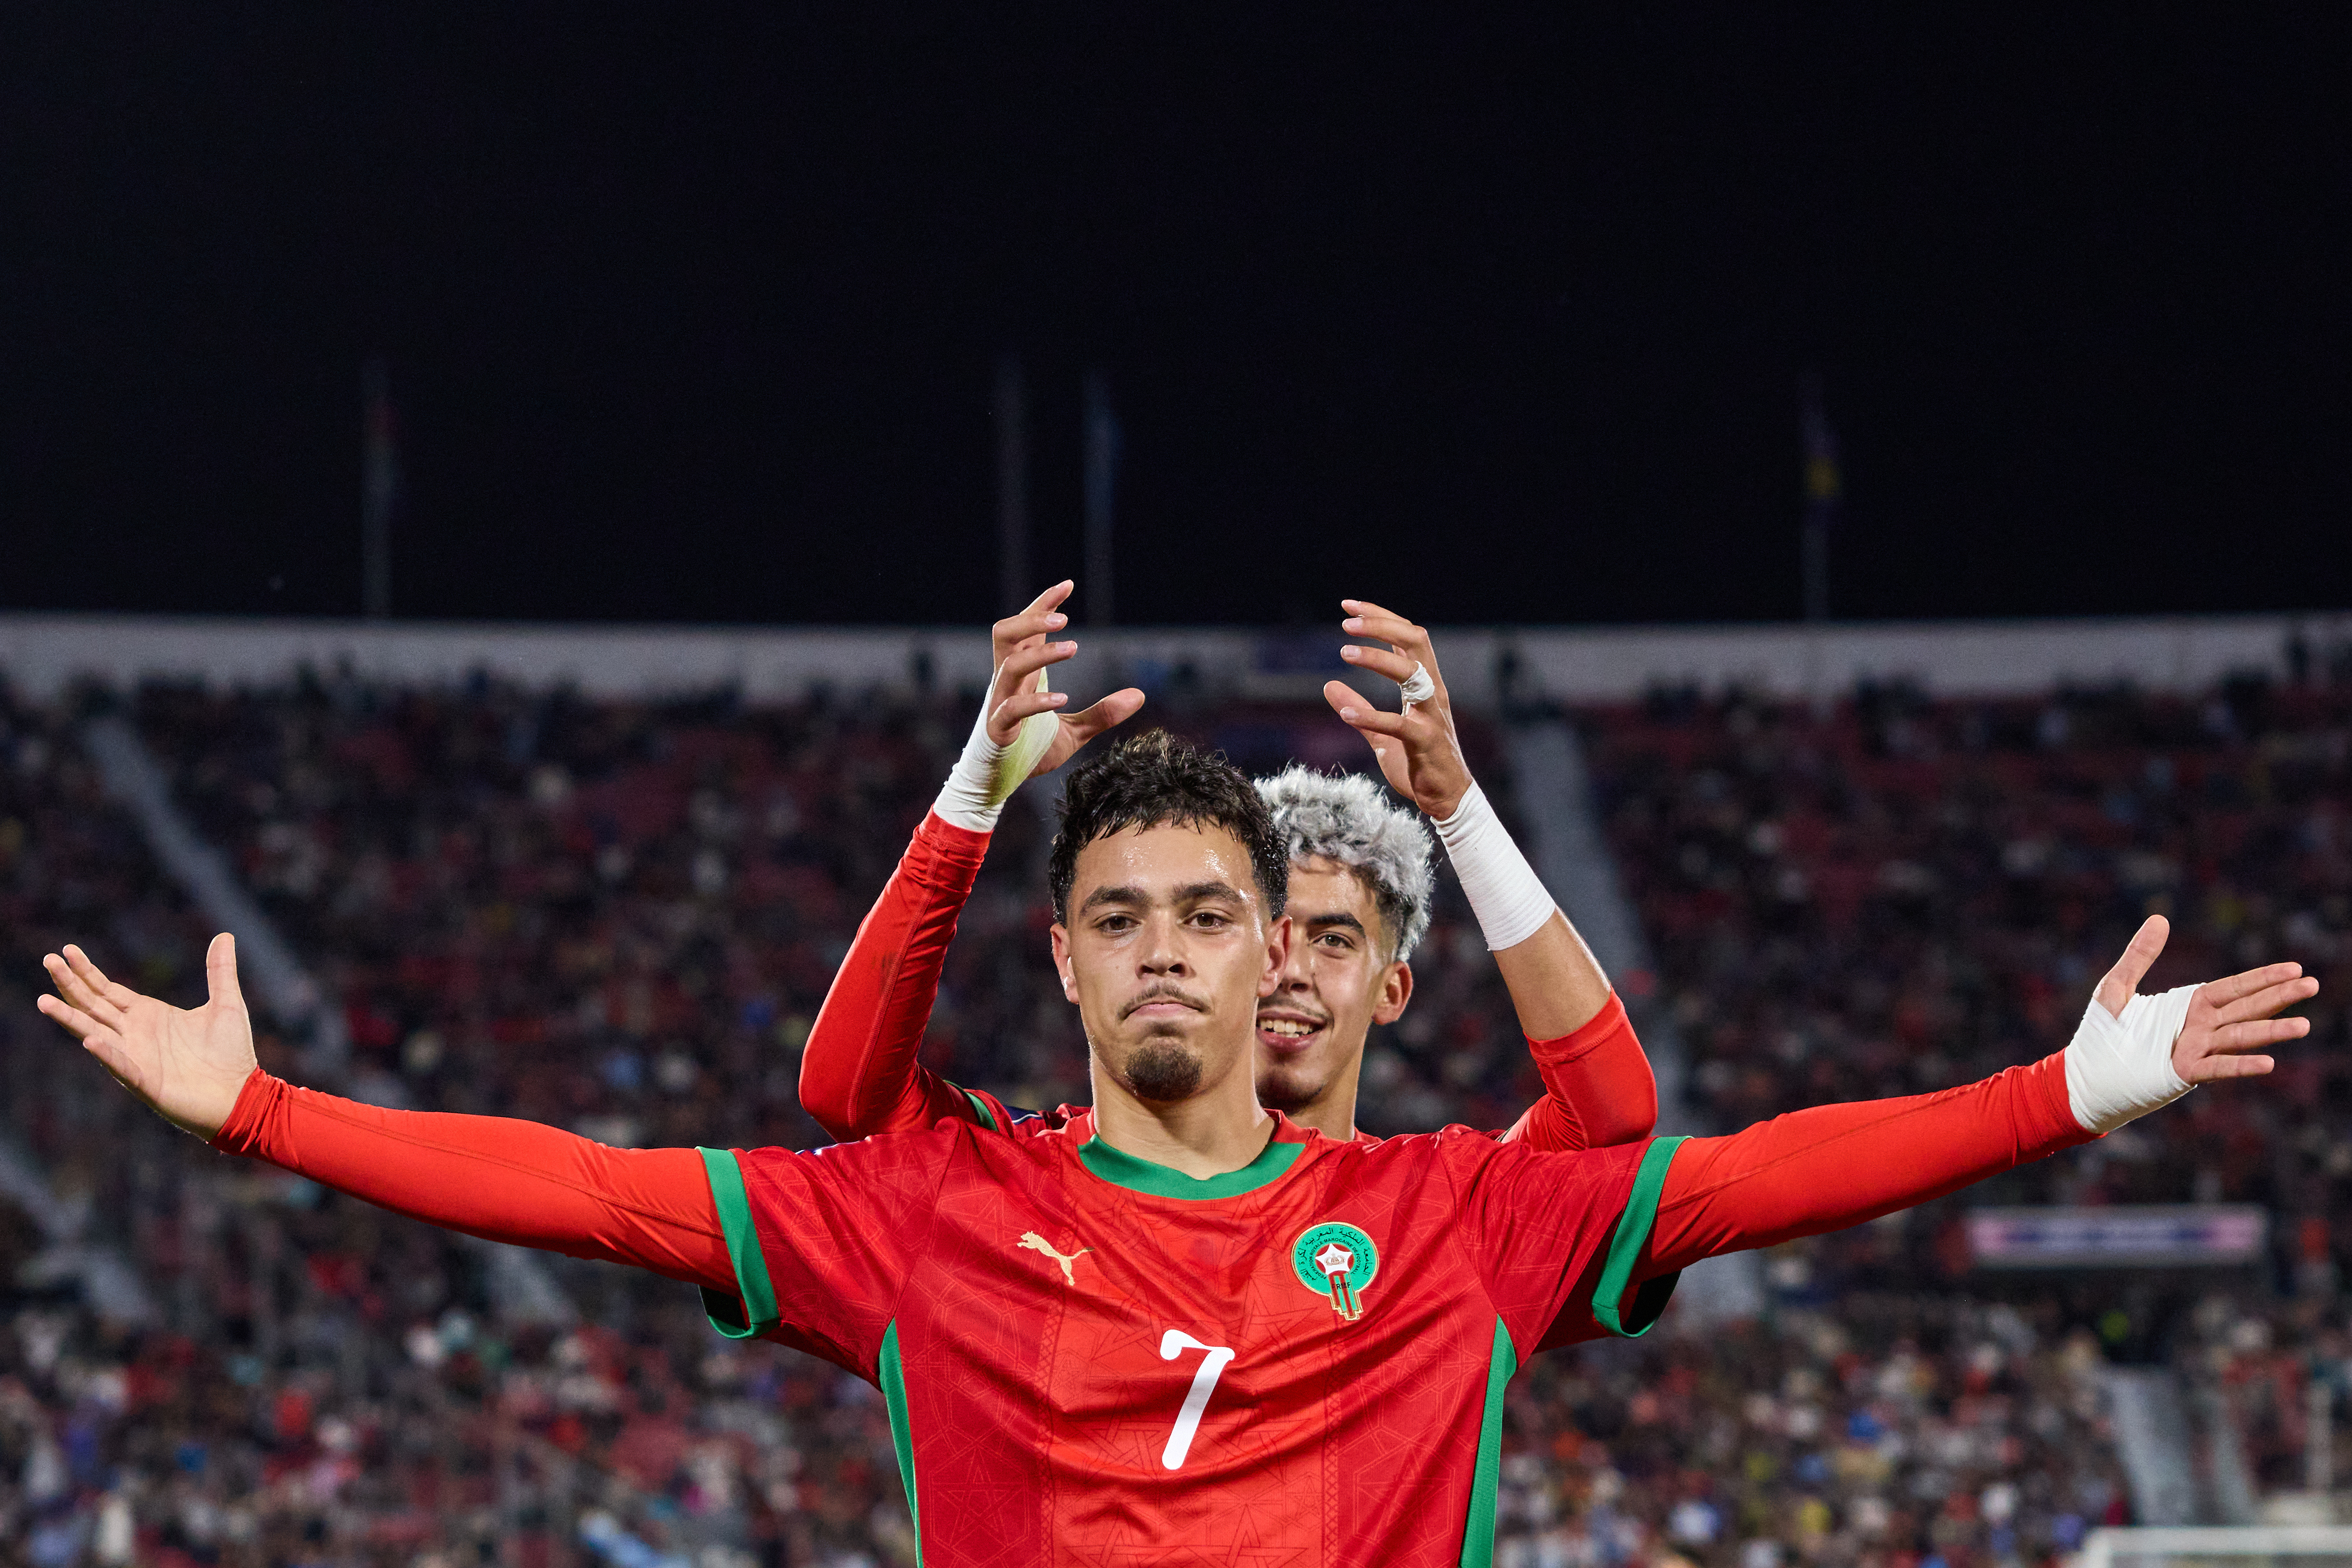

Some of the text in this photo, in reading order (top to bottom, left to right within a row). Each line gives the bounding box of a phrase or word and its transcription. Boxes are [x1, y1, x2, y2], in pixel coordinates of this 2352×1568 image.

[1302, 1227, 1334, 1246] المغربية
[1339, 1228, 1365, 1246] الملكية
[1298, 1248, 1307, 1265] لكرة
[1310, 1241, 1323, 1255] ROYALE
[1324, 1238, 1353, 1248] MAROCAINE
[1351, 1253, 1361, 1275] FOOTBALL
[1363, 1248, 1373, 1275] الجامعة
[1160, 1329, 1235, 1470] 7
